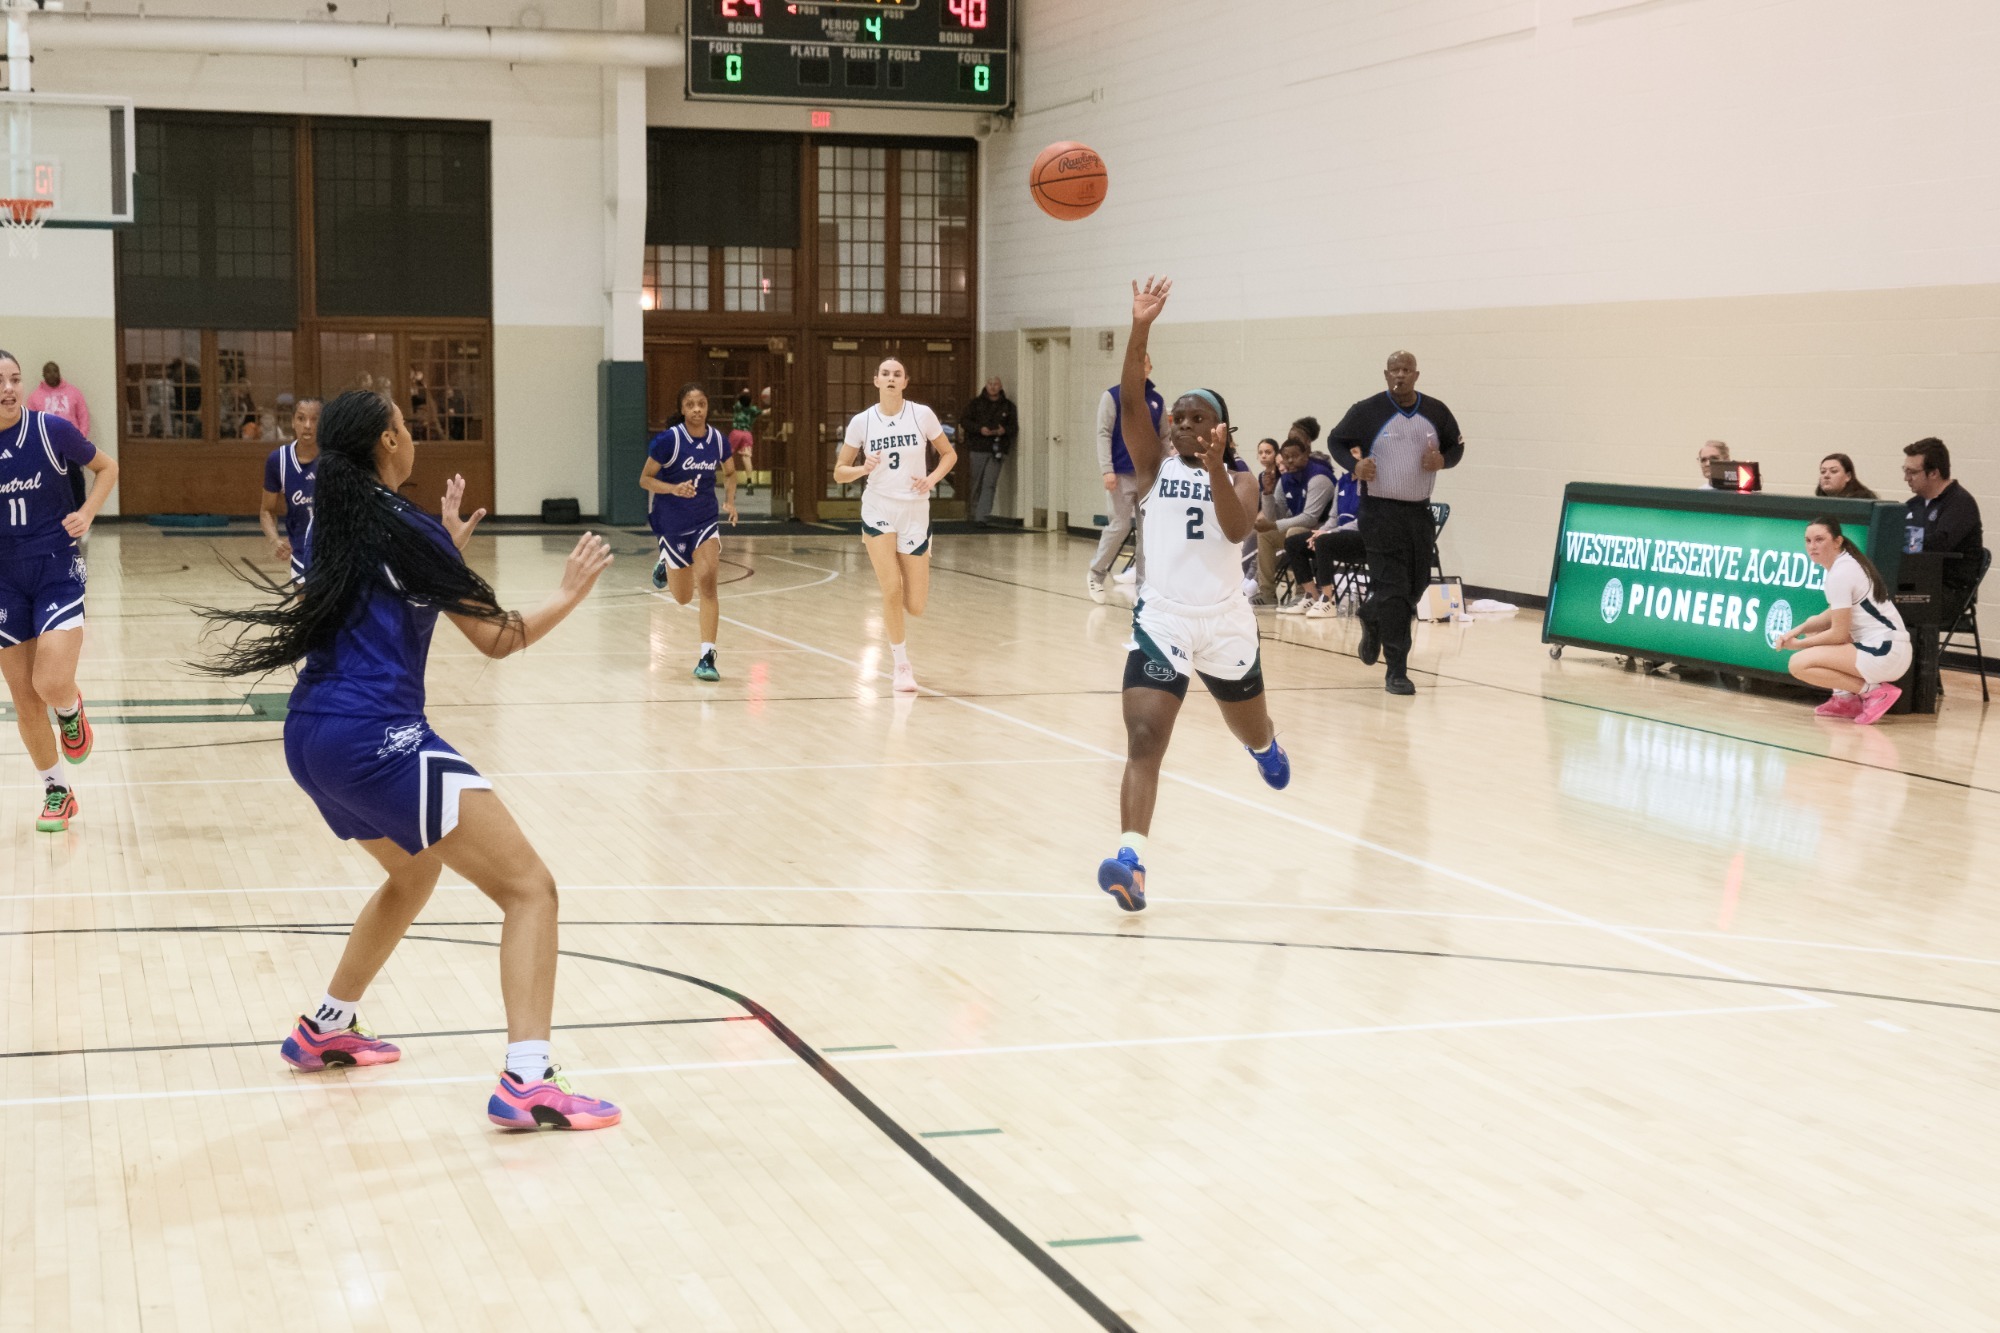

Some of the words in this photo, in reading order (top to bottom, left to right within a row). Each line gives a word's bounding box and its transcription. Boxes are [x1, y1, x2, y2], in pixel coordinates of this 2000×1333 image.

[948, 0, 987, 28] 40
[728, 22, 764, 35] BONUS
[821, 19, 860, 31] PERIOD
[865, 17, 881, 41] 4
[939, 32, 974, 44] BONUS
[709, 42, 743, 53] FOULS
[790, 46, 830, 58] PLAYER
[843, 47, 881, 60] POINTS
[888, 50, 921, 61] FOULS
[726, 55, 742, 82] 0
[958, 53, 990, 64] FOULS
[974, 65, 990, 91] 0
[870, 434, 918, 452] RESERVE
[682, 456, 717, 471] Central
[888, 452, 900, 469] 3
[8, 498, 27, 526] 11
[1186, 507, 1204, 540] 2
[1566, 531, 1652, 571] WESTERN
[1650, 539, 1743, 581] RESERVE
[1627, 583, 1761, 633] PIONEERS
